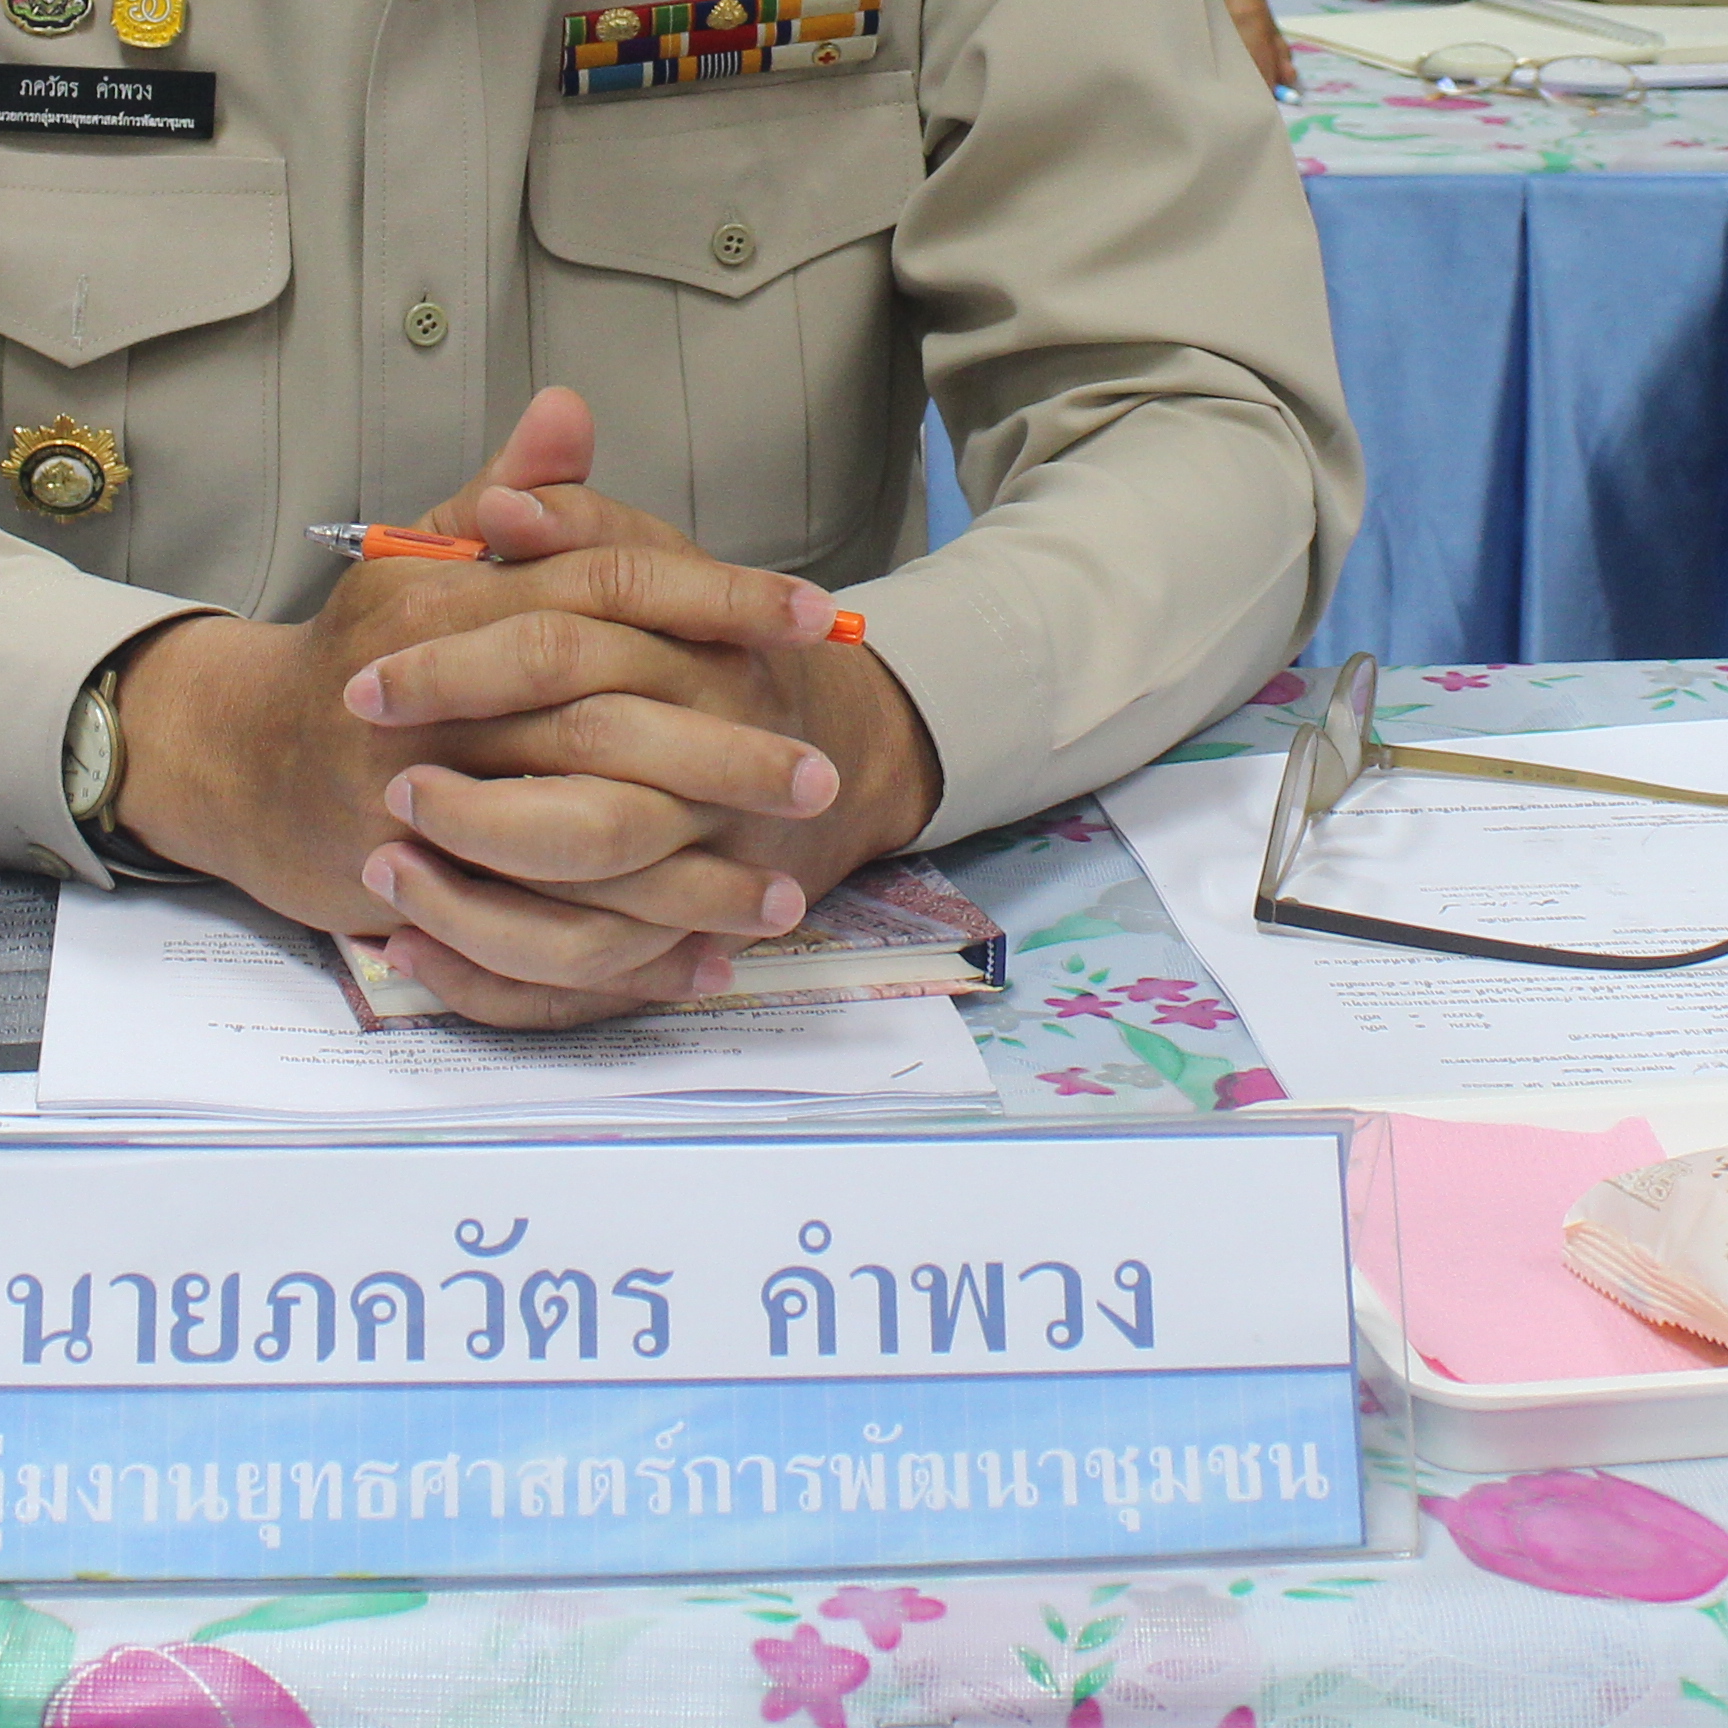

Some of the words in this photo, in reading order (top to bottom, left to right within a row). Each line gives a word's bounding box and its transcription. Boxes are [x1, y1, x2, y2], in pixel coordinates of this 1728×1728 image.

[19, 75, 79, 99] ภควัตร
[96, 75, 153, 101] คำพวง
[6, 1215, 674, 1365] นายภควัตร
[760, 1218, 1156, 1359] คำพวง
